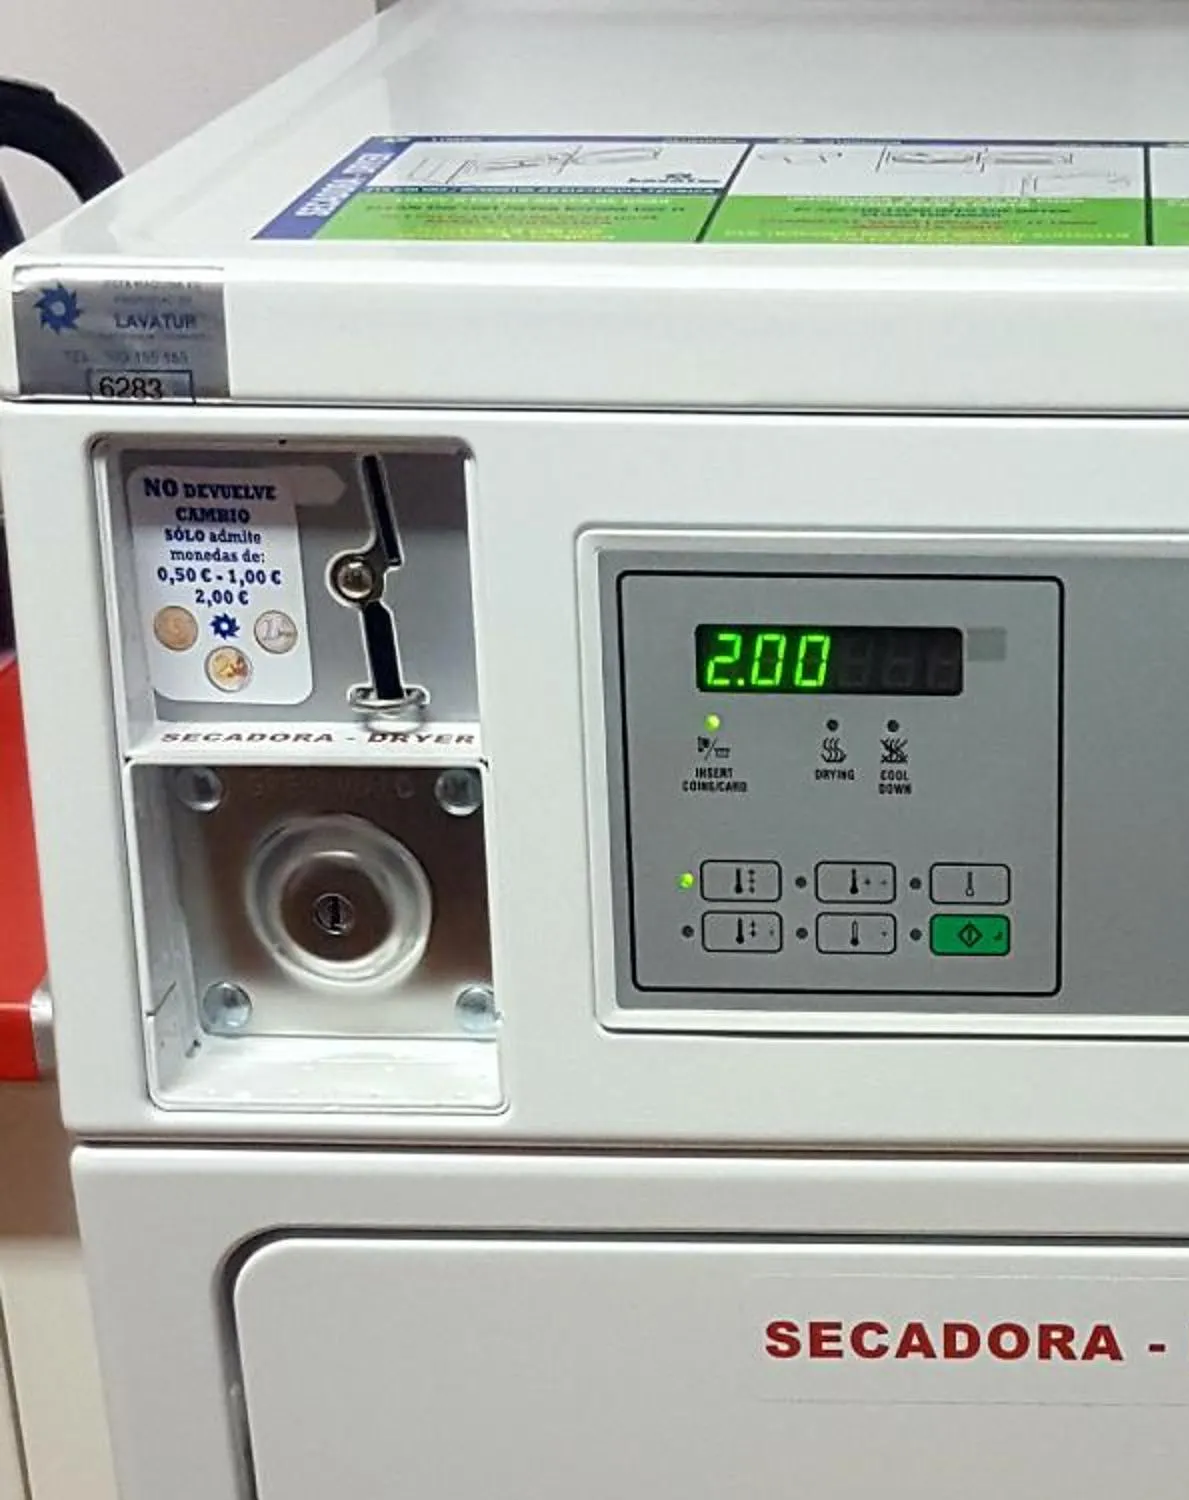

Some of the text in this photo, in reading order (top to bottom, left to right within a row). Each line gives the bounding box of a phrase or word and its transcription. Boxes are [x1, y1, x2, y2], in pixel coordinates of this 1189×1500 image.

[99, 375, 162, 399] 6283
[143, 478, 277, 500] NO DEVUELVE
[176, 506, 251, 523] CAMBIO
[165, 528, 261, 544] SÓLO admite
[170, 546, 265, 563] monedas de:
[158, 568, 196, 585] 0,50
[200, 569, 213, 583] €
[228, 569, 265, 588] 1,00
[270, 570, 282, 585] €
[195, 589, 249, 606] 2,00 €
[706, 632, 831, 687] 2.00
[161, 732, 334, 742] SECADORA
[368, 732, 475, 744] DRYER
[695, 767, 733, 779] INSERT
[815, 769, 855, 781] DRYING
[880, 770, 909, 781] COOL
[878, 783, 912, 795] DOWN
[763, 1319, 1125, 1362] SECADORA
